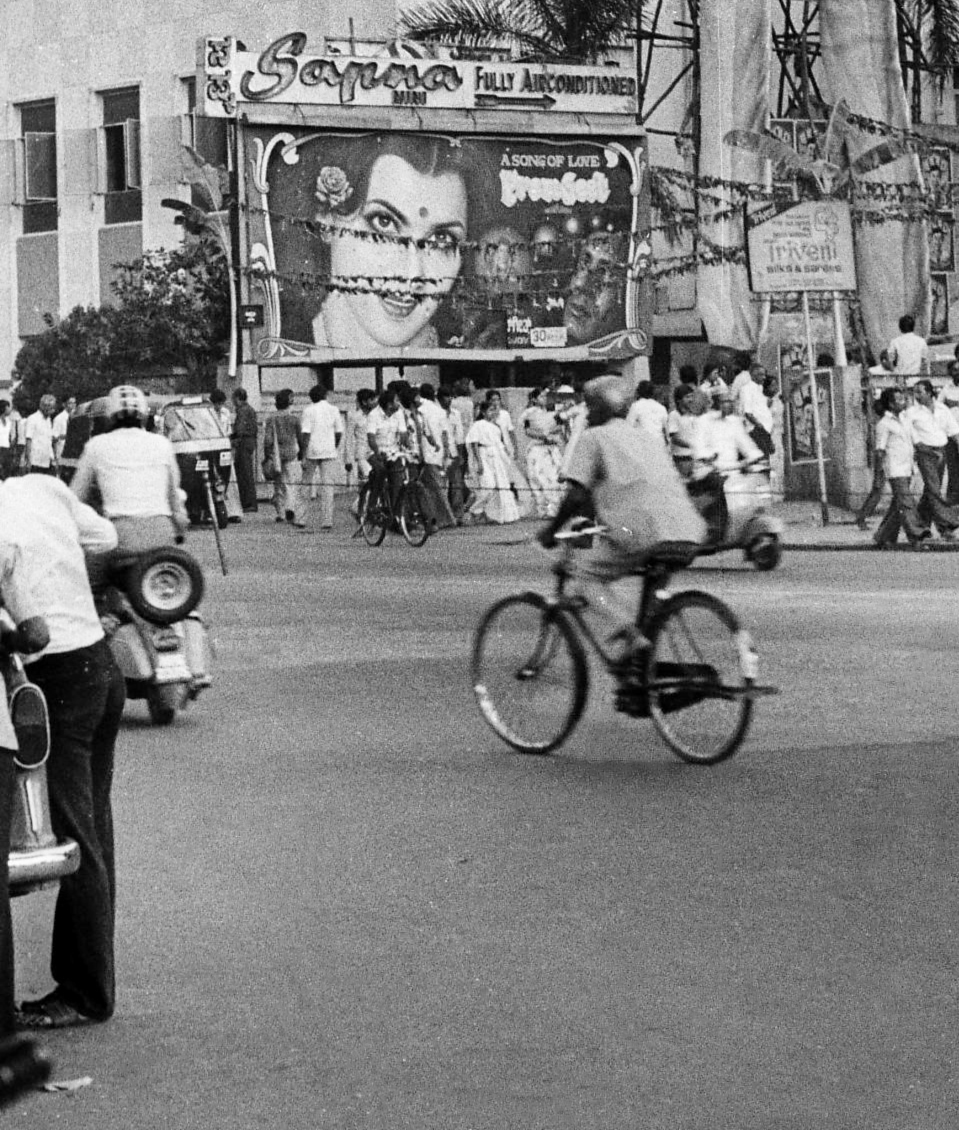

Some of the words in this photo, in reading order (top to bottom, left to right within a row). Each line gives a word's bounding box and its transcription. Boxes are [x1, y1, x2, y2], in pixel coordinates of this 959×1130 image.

[240, 32, 463, 104] Sapna
[474, 65, 515, 92] FULLY
[519, 67, 636, 96] AIRCONDITIONED
[391, 89, 428, 106] MINI
[500, 153, 511, 167] A
[511, 154, 546, 168] SONG
[546, 154, 565, 168] OF
[567, 154, 600, 168] LOVE
[768, 241, 838, 262] Triveni
[532, 329, 547, 342] 30
